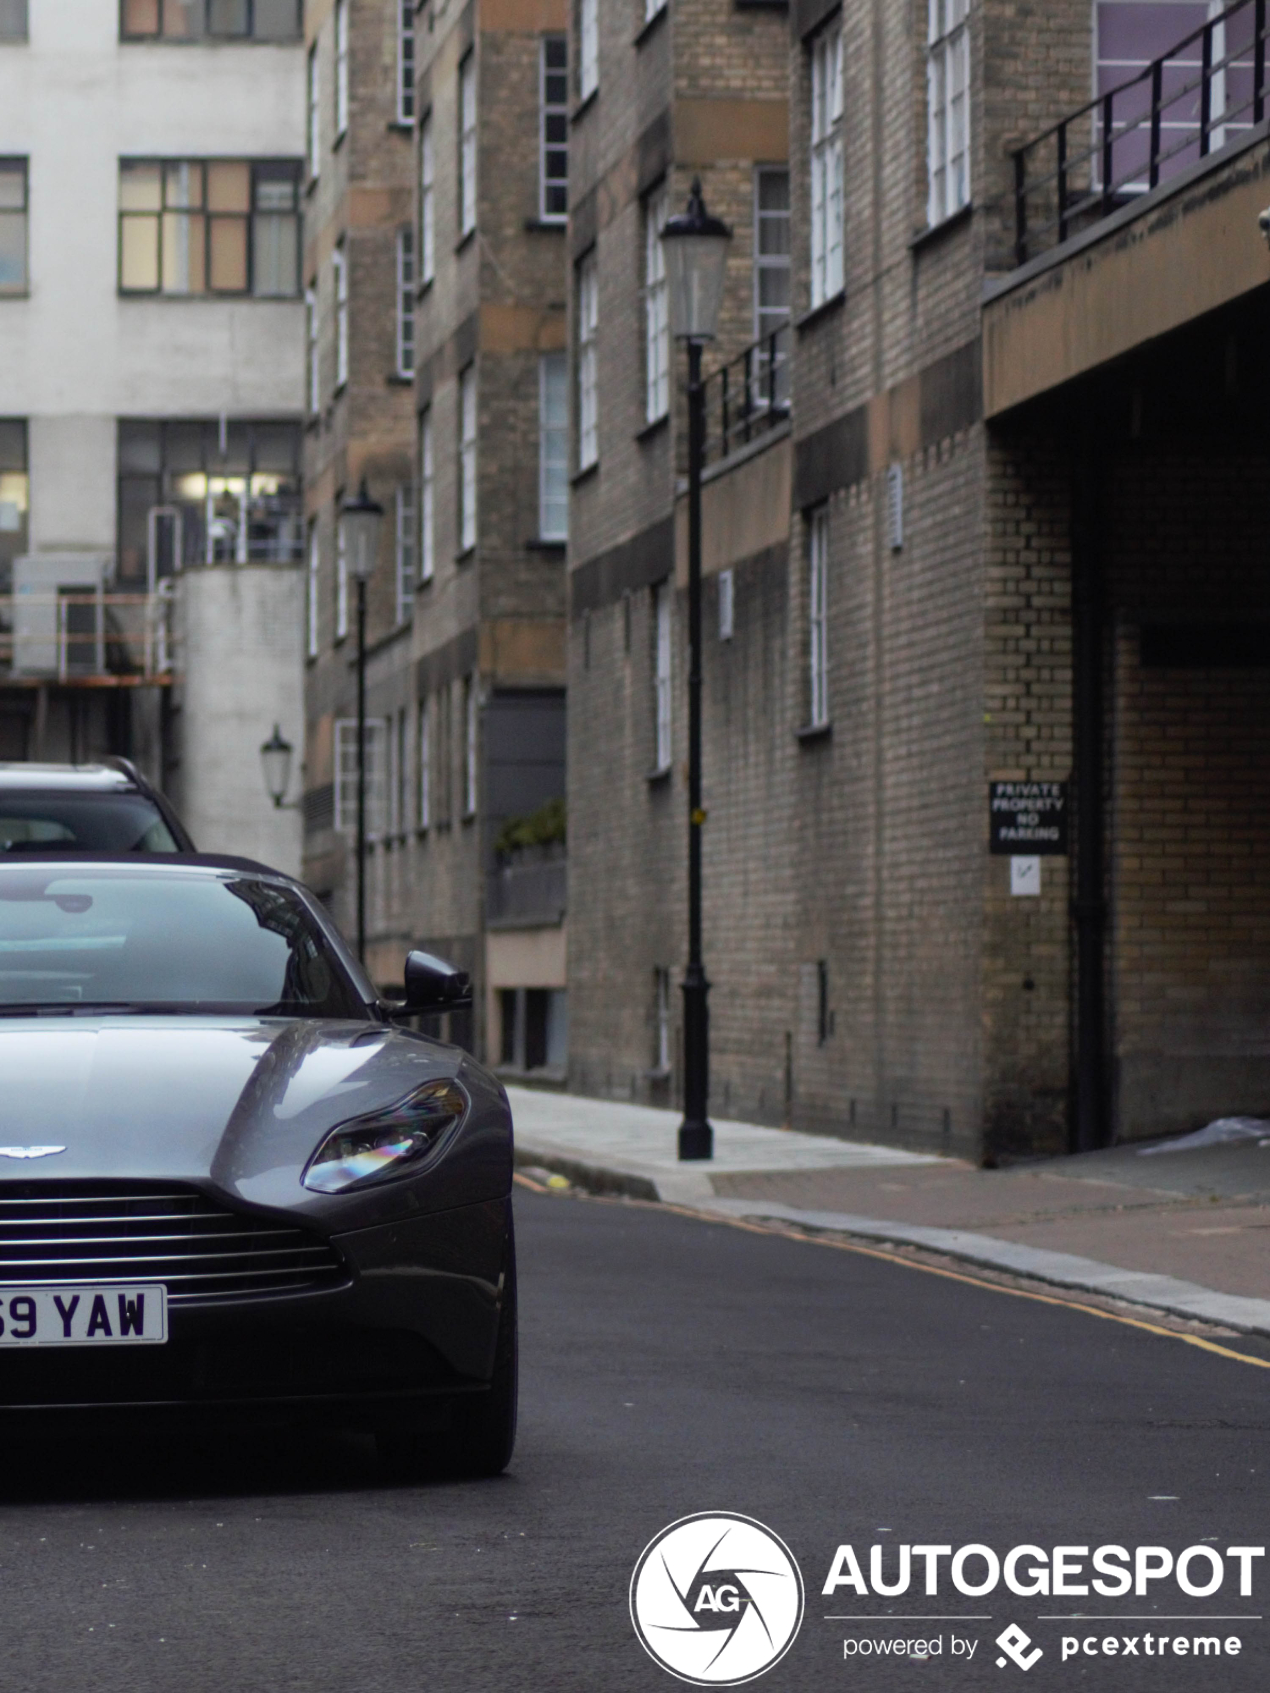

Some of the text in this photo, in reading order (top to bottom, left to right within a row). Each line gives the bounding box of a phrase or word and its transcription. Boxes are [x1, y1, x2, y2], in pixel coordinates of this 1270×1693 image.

[996, 783, 1060, 796] PRIVATE
[992, 797, 1064, 811] PROPERTY
[1016, 813, 1040, 826] NO
[999, 827, 1060, 841] PARKING
[53, 1293, 145, 1337] YAW
